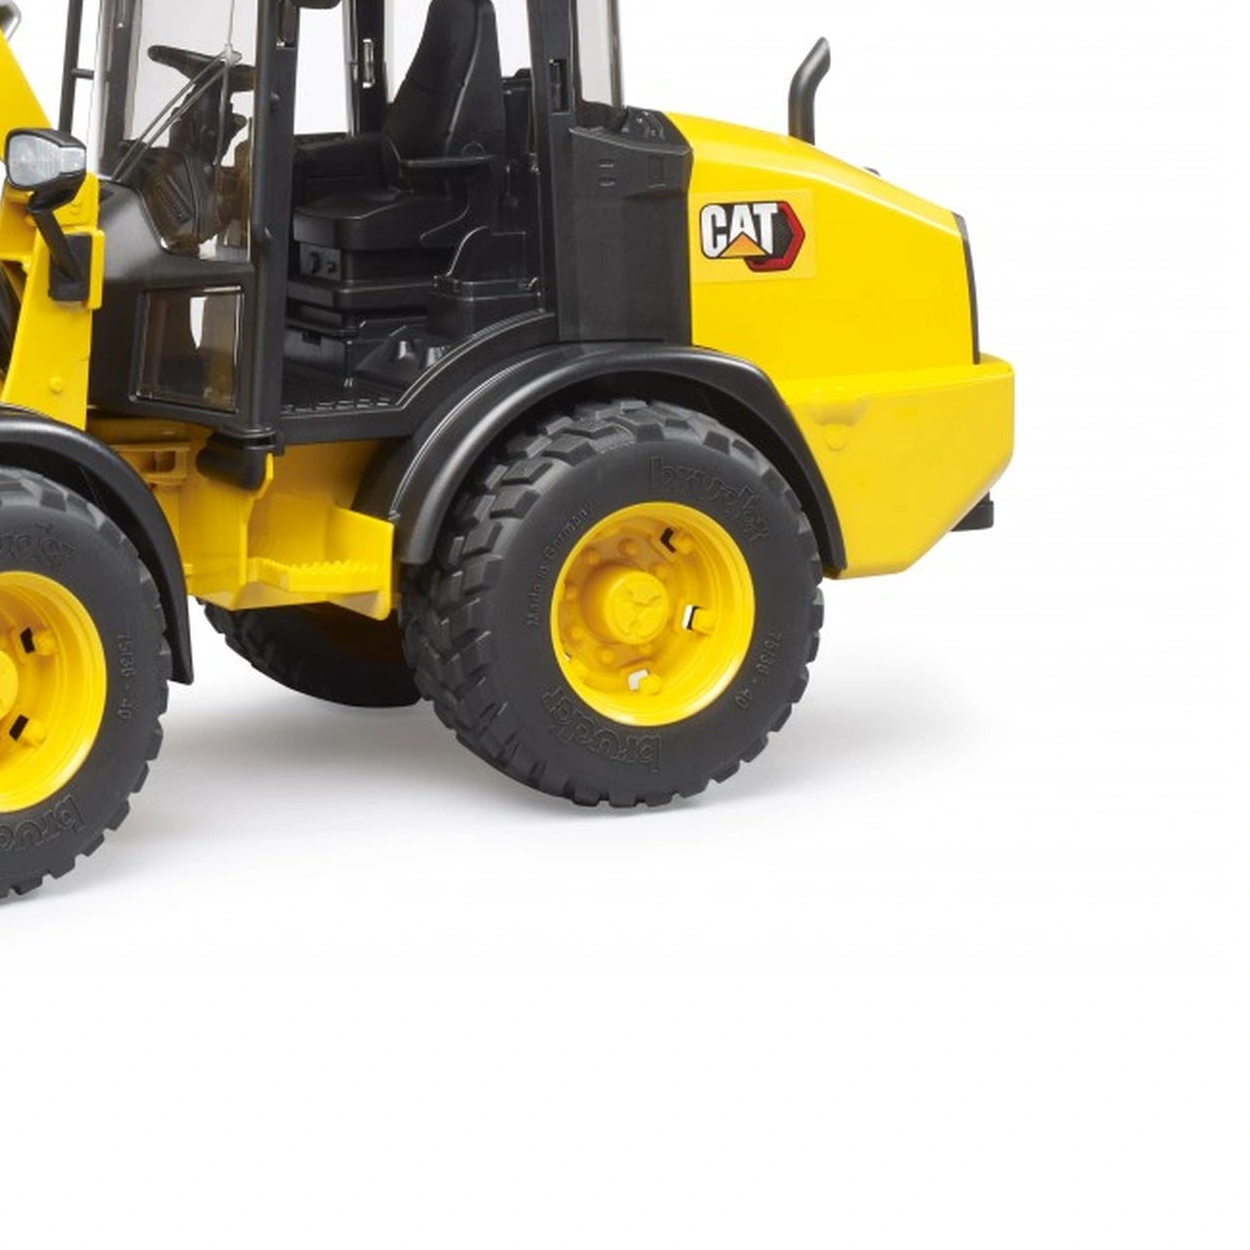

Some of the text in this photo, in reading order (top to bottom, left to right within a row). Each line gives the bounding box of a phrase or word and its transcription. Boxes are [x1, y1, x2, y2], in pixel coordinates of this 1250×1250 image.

[700, 203, 779, 259] CAT
[651, 456, 770, 542] bruder
[541, 686, 661, 774] bruder
